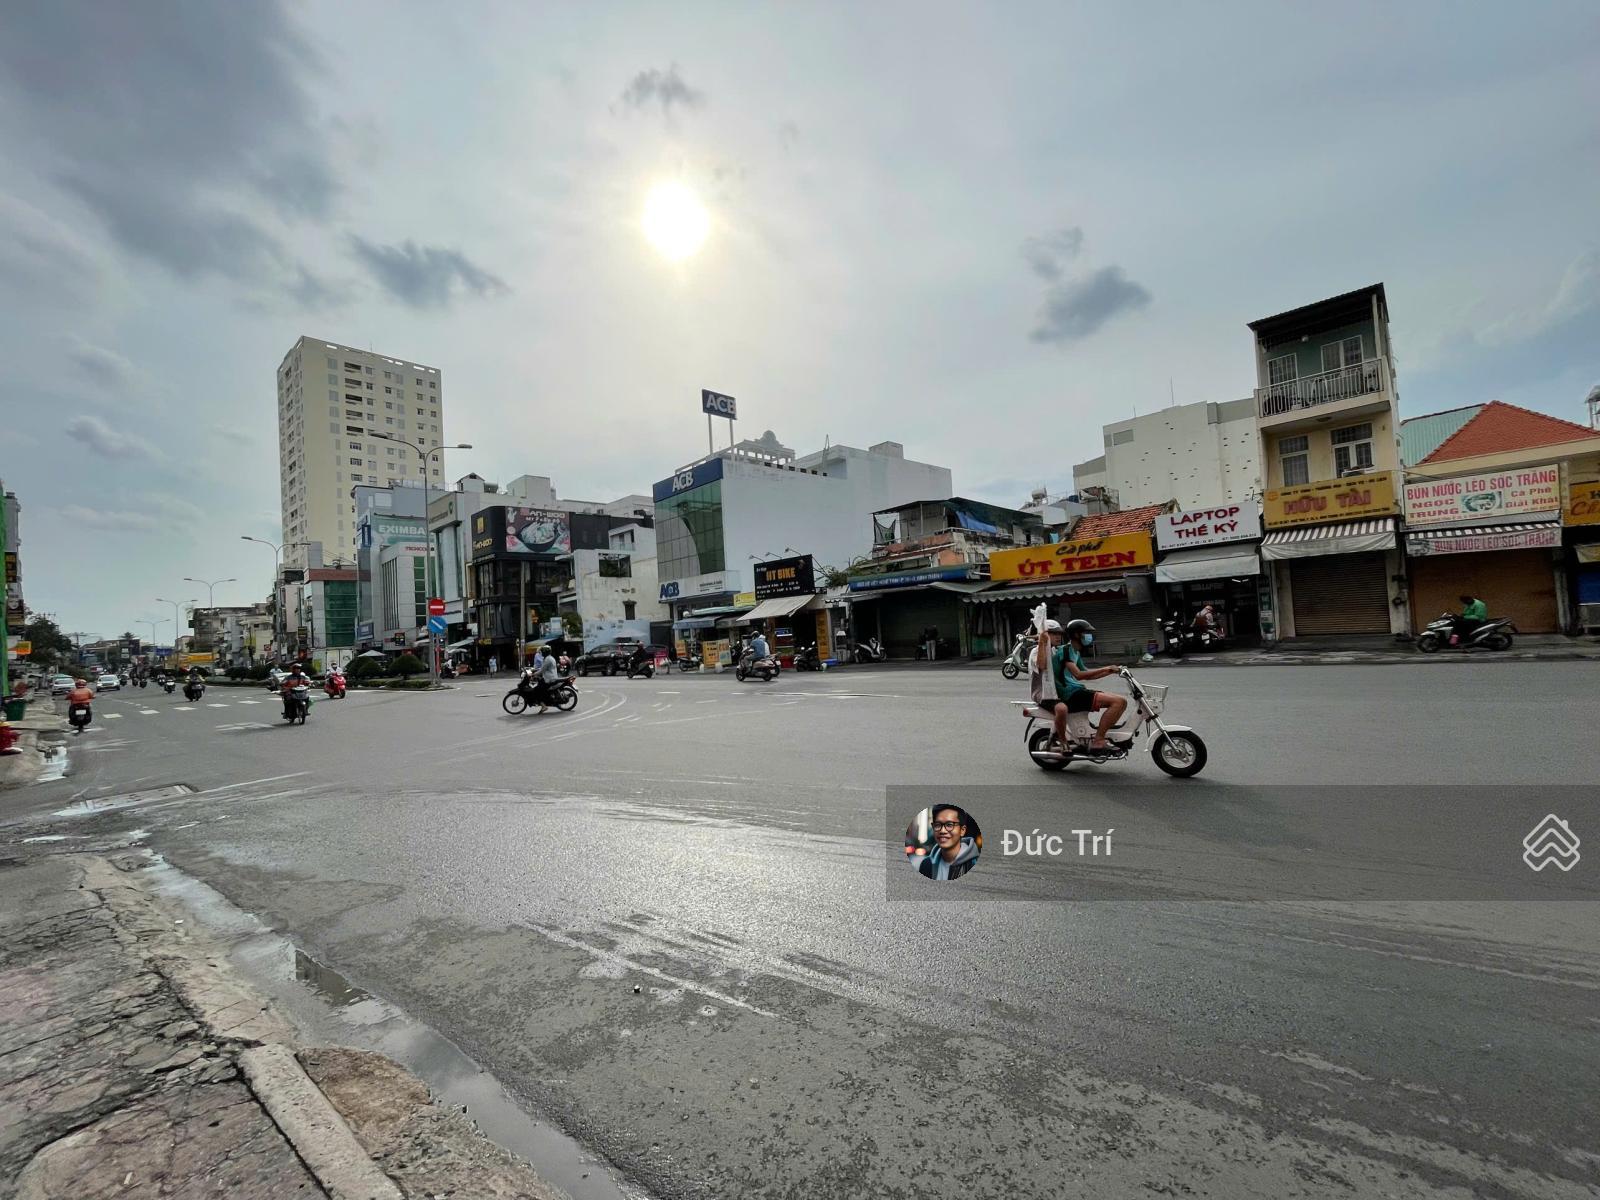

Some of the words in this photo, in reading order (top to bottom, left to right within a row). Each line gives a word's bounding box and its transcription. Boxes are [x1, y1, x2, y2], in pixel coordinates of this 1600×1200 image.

[706, 394, 736, 414] ACB
[672, 471, 694, 492] ACB
[1170, 507, 1240, 525] LAPTOP
[1407, 508, 1459, 518] TRUNG
[1017, 558, 1052, 576] ÚT
[1061, 550, 1136, 572] TEEN
[777, 567, 796, 579] BIKE
[660, 581, 680, 599] ACB
